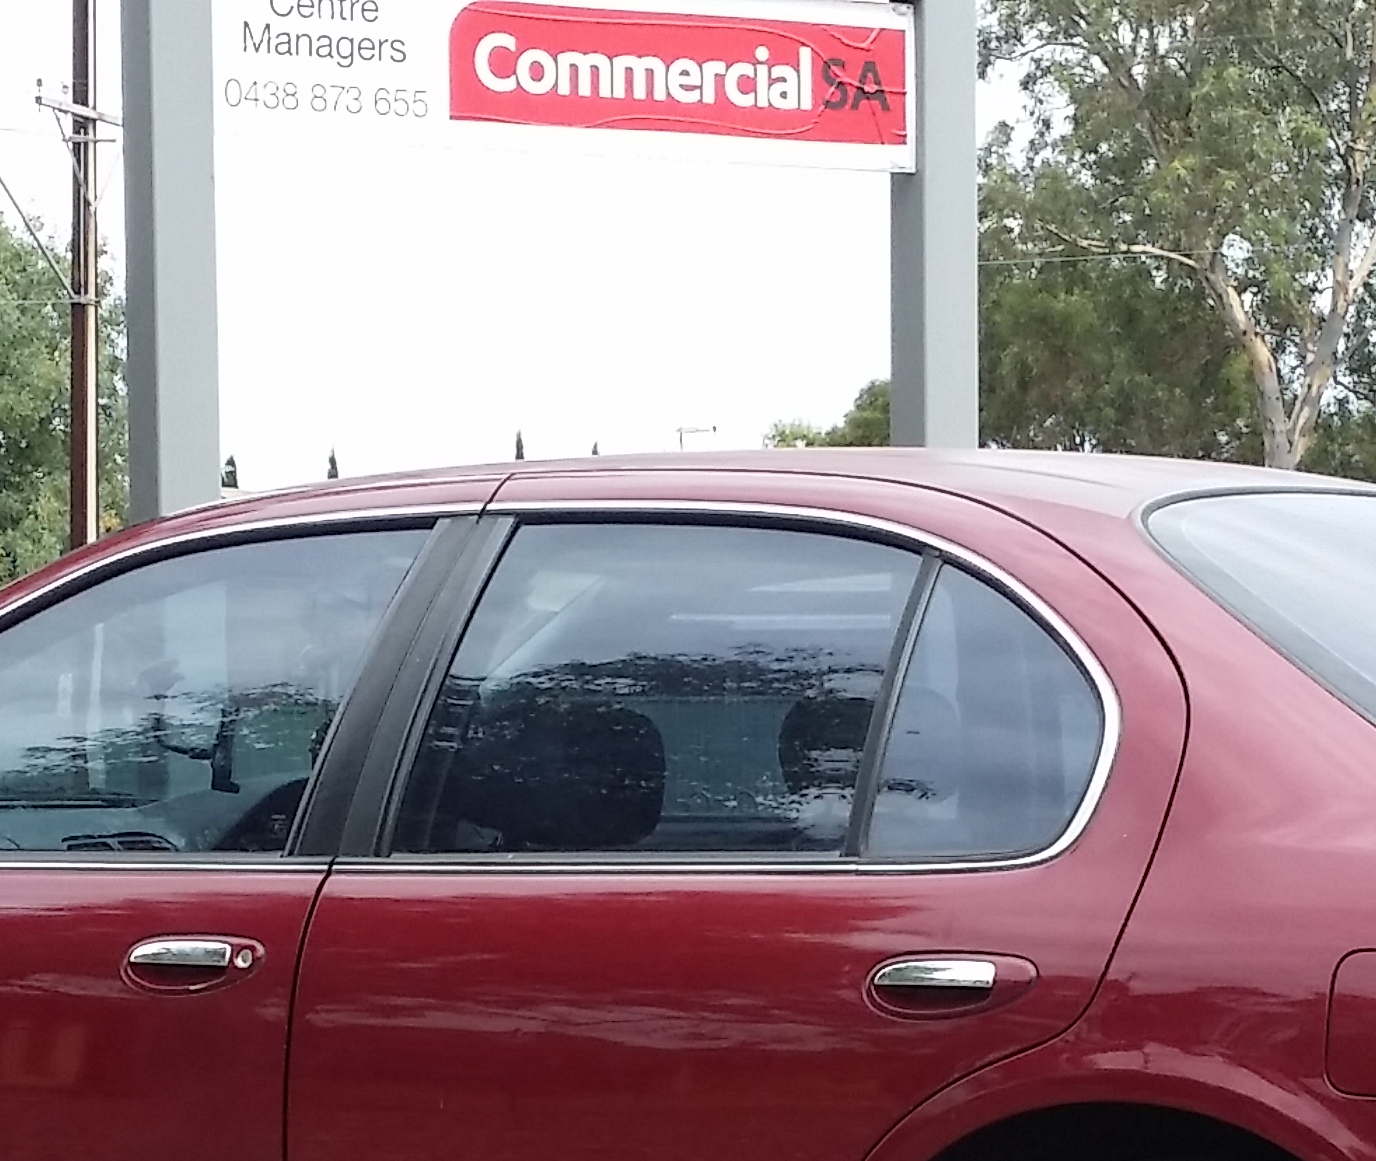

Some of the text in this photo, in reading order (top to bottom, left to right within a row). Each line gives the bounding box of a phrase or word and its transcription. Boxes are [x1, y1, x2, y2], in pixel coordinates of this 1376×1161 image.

[242, 20, 408, 69] Managers
[224, 78, 429, 118] 0438 873 655
